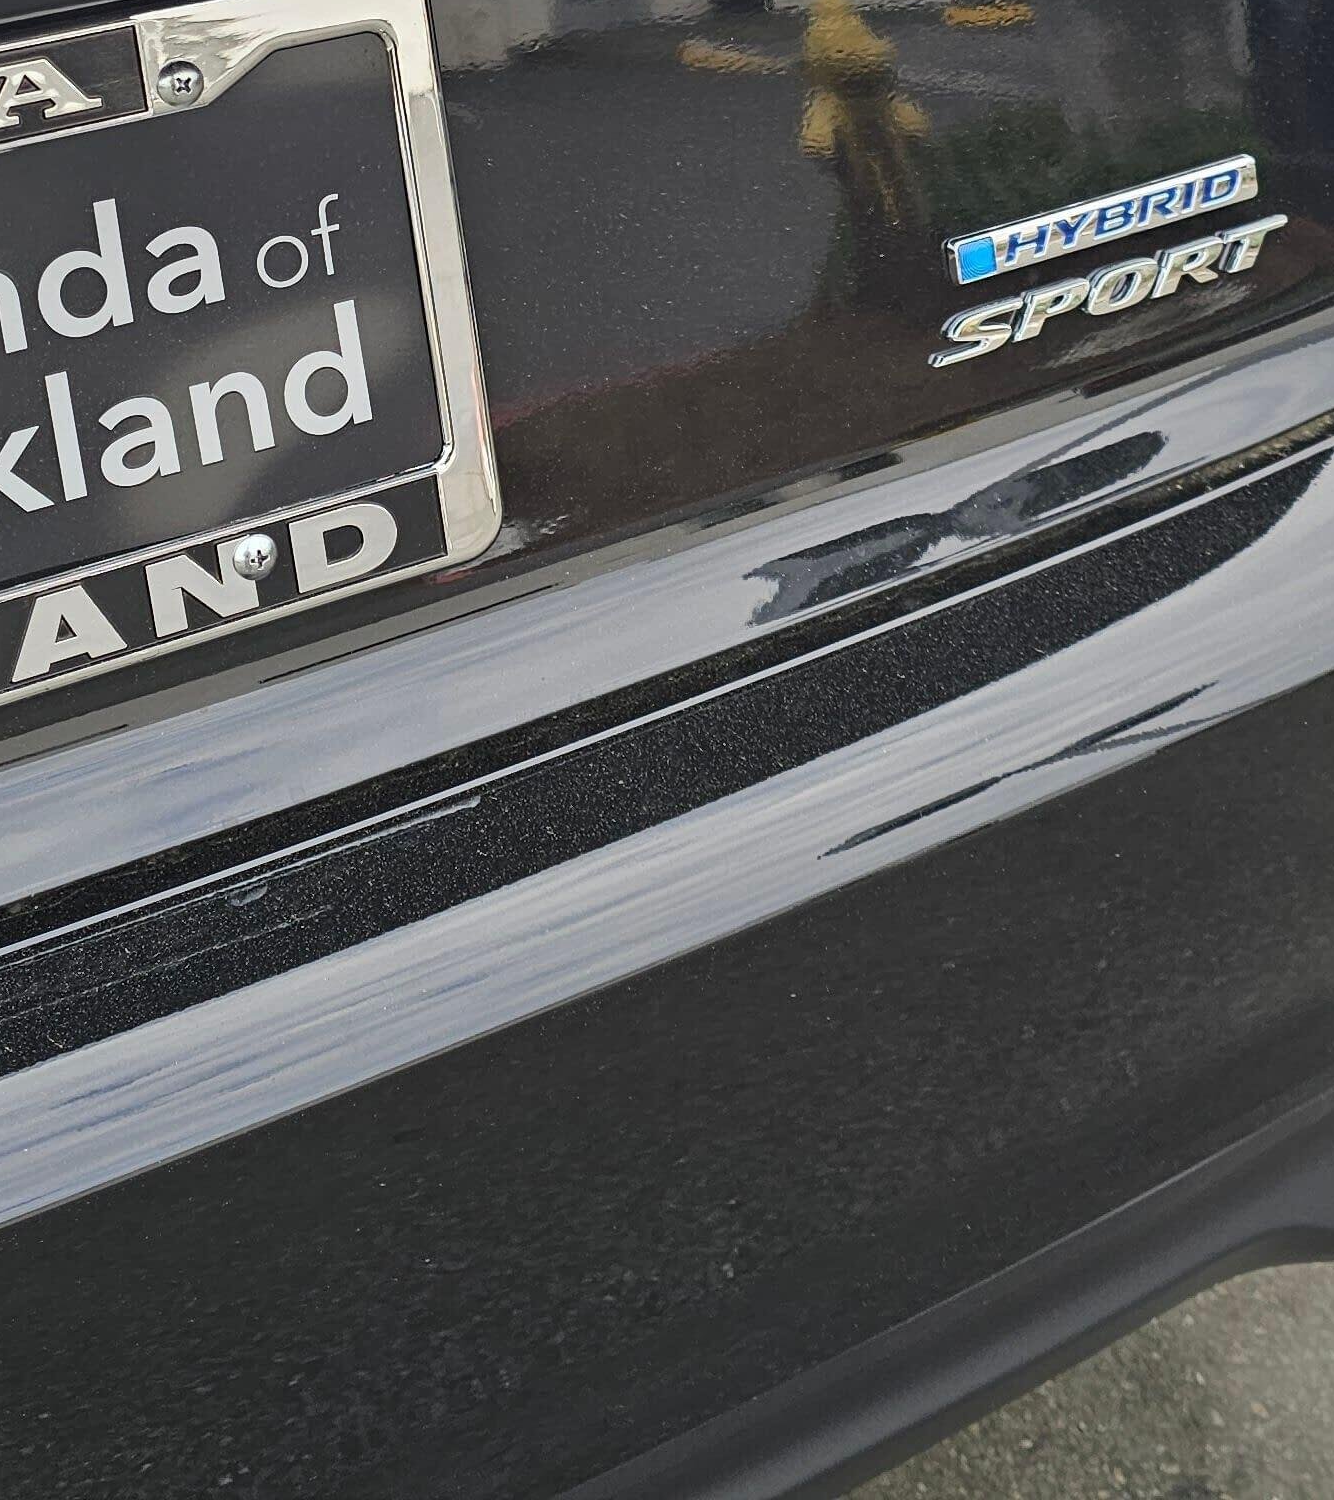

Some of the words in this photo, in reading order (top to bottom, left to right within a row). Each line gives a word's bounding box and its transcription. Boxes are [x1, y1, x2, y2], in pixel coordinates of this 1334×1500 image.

[254, 194, 341, 289] of
[1004, 168, 1241, 266] HYBRID
[928, 213, 1289, 368] SPORT
